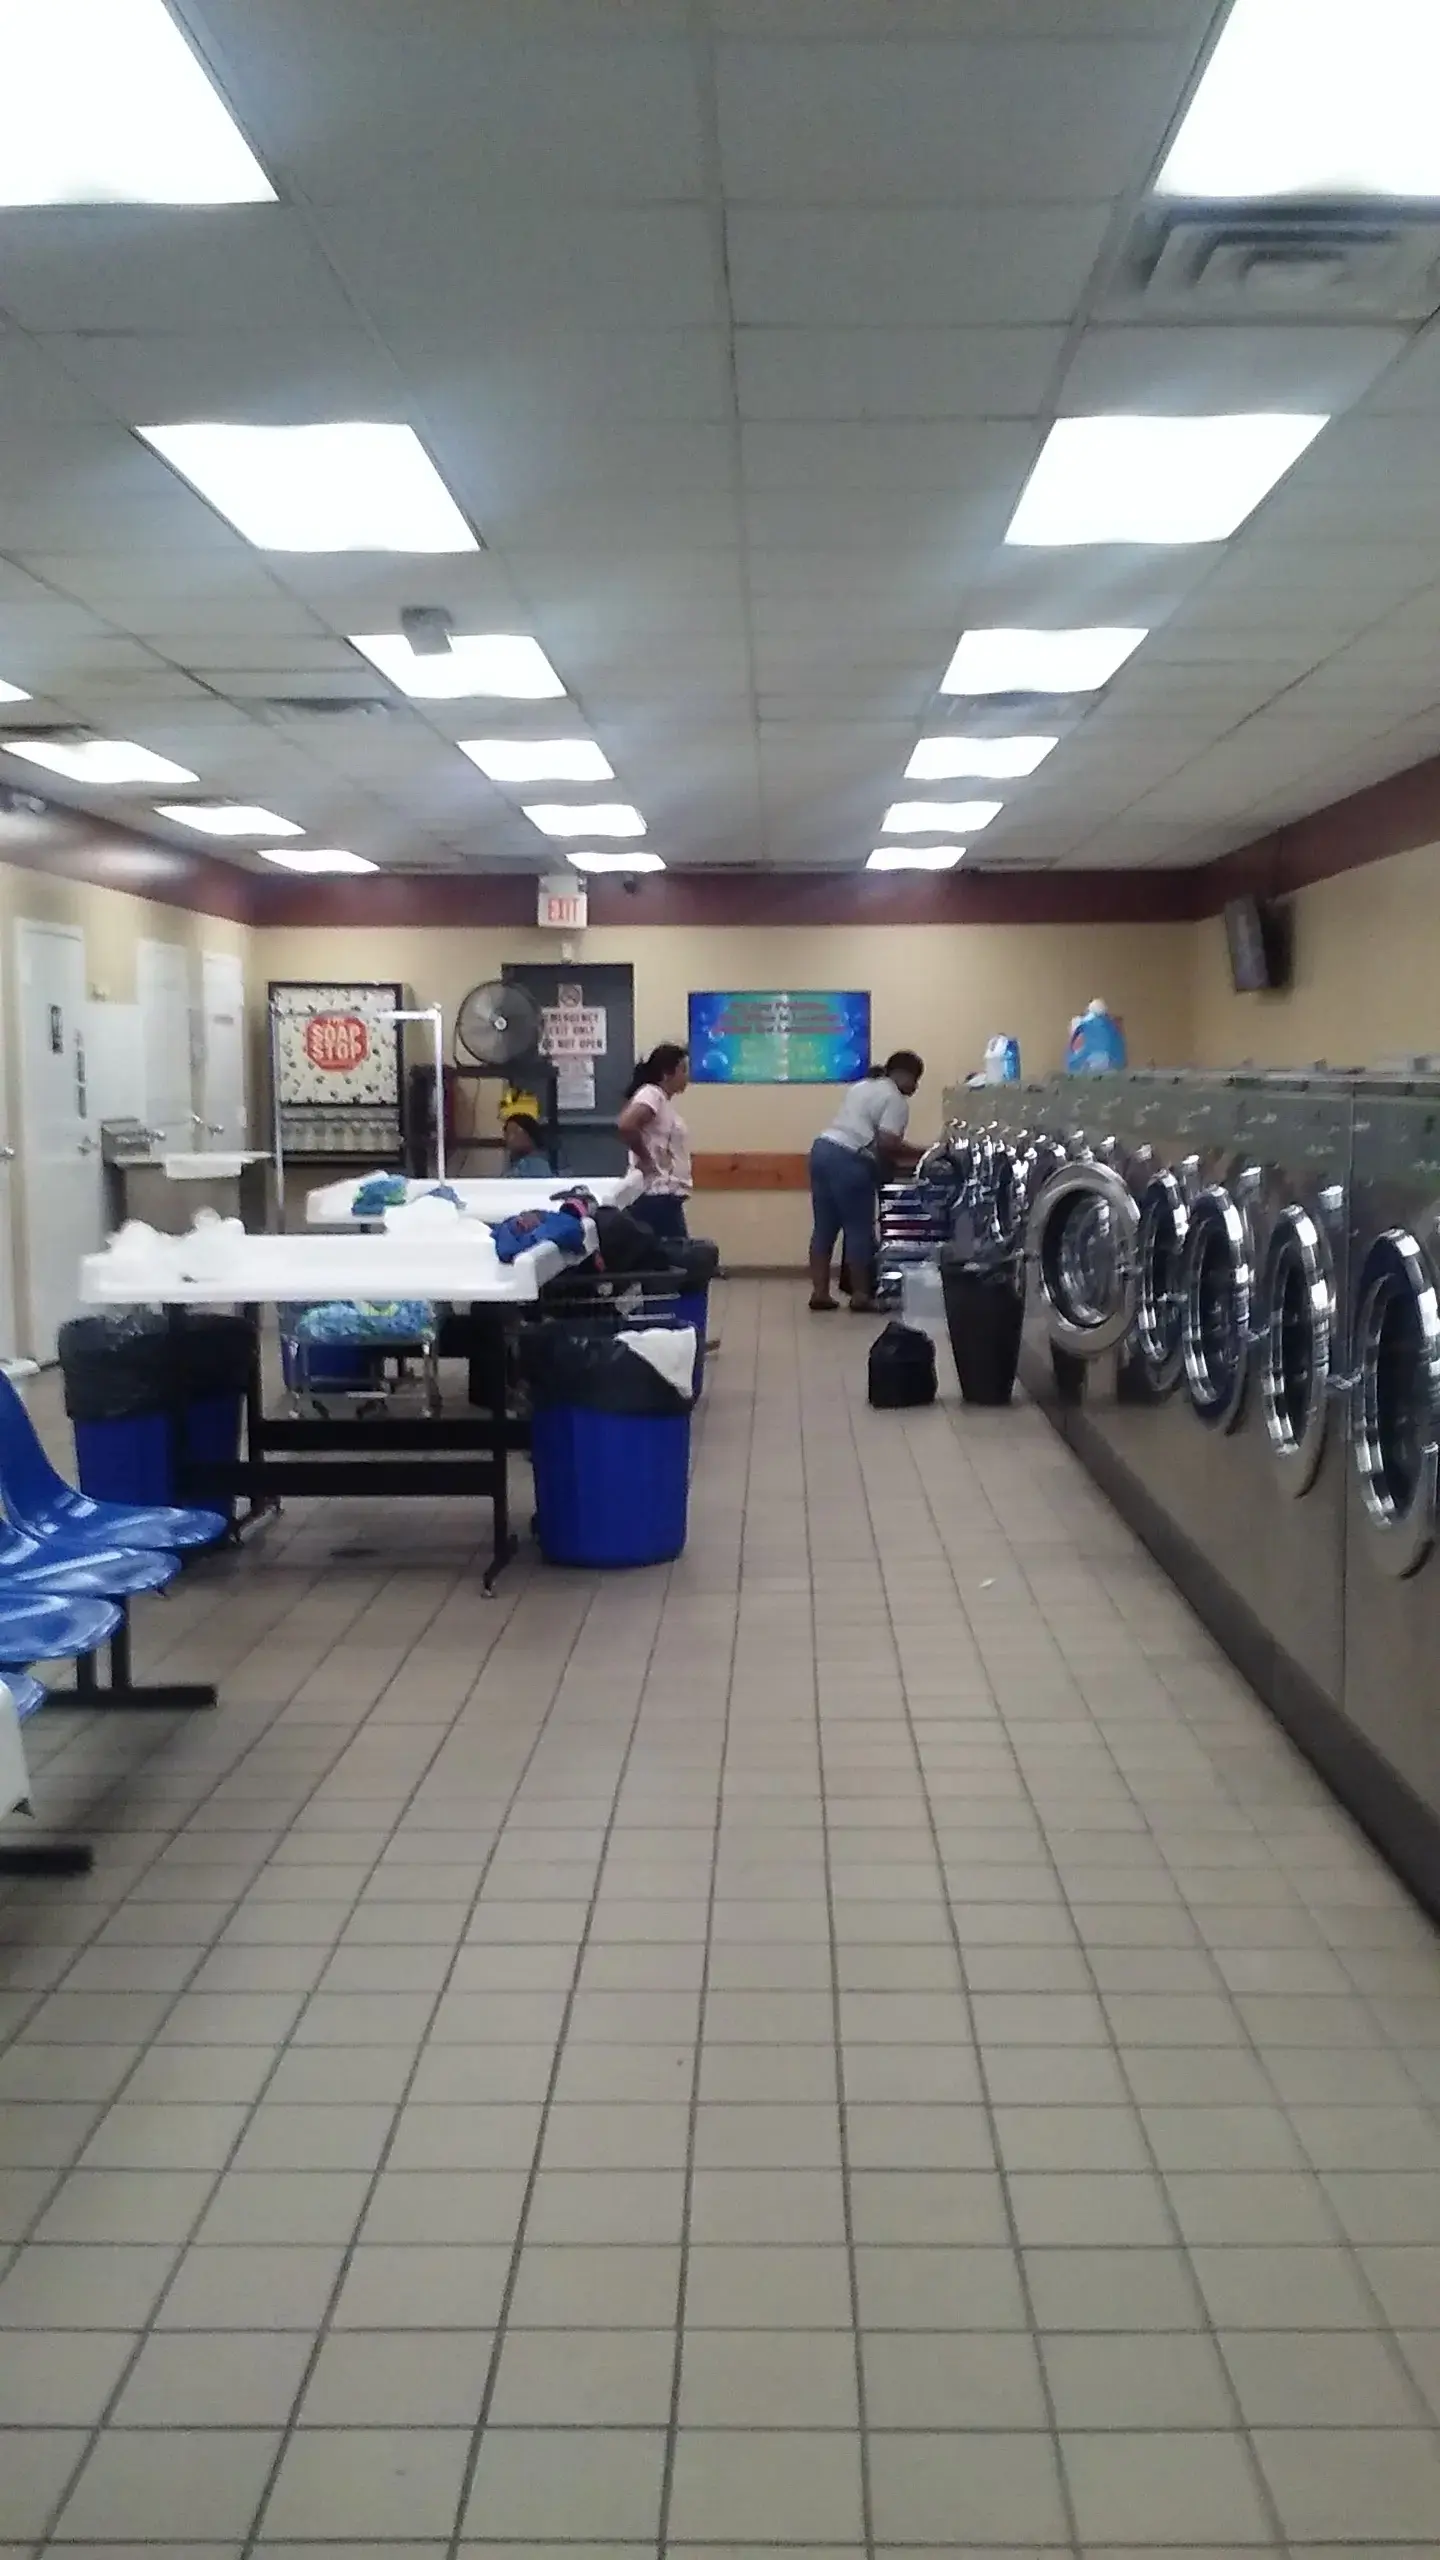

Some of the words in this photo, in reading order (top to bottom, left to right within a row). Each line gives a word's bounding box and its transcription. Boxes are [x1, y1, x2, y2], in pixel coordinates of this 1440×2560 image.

[548, 898, 579, 922] EXIT
[312, 1024, 361, 1042] SOAP
[573, 1026, 594, 1035] ONLY
[312, 1042, 362, 1060] STOP
[558, 1039, 575, 1049] NOT
[579, 1039, 603, 1049] OPEN
